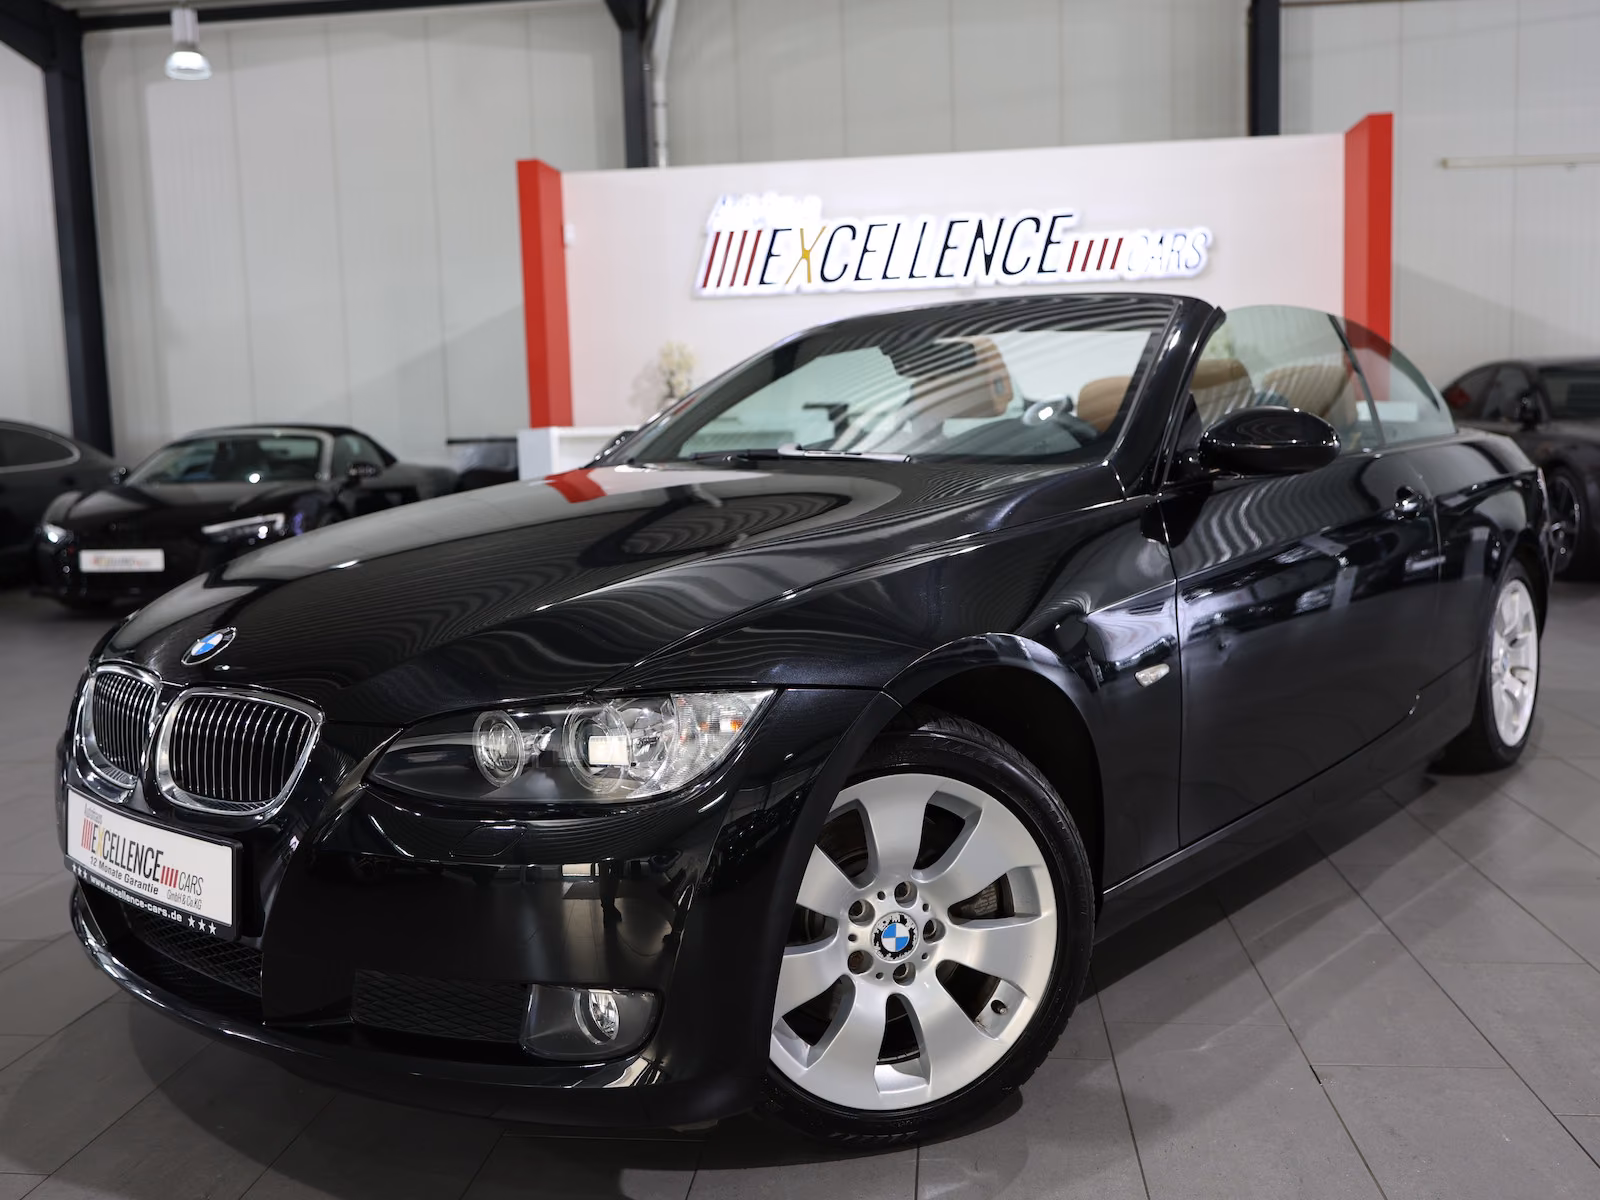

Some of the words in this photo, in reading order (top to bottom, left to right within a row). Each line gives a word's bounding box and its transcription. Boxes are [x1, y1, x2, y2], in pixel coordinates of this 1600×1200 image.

[760, 215, 1074, 286] EXCELLENCE
[1127, 232, 1211, 272] CARS
[90, 856, 98, 867] 12
[99, 861, 123, 880] Monate
[124, 875, 159, 895] Garantie
[91, 824, 164, 882] EXCELLENCE
[178, 872, 204, 896] CARS
[90, 875, 182, 922] www.excellence-cars.de
